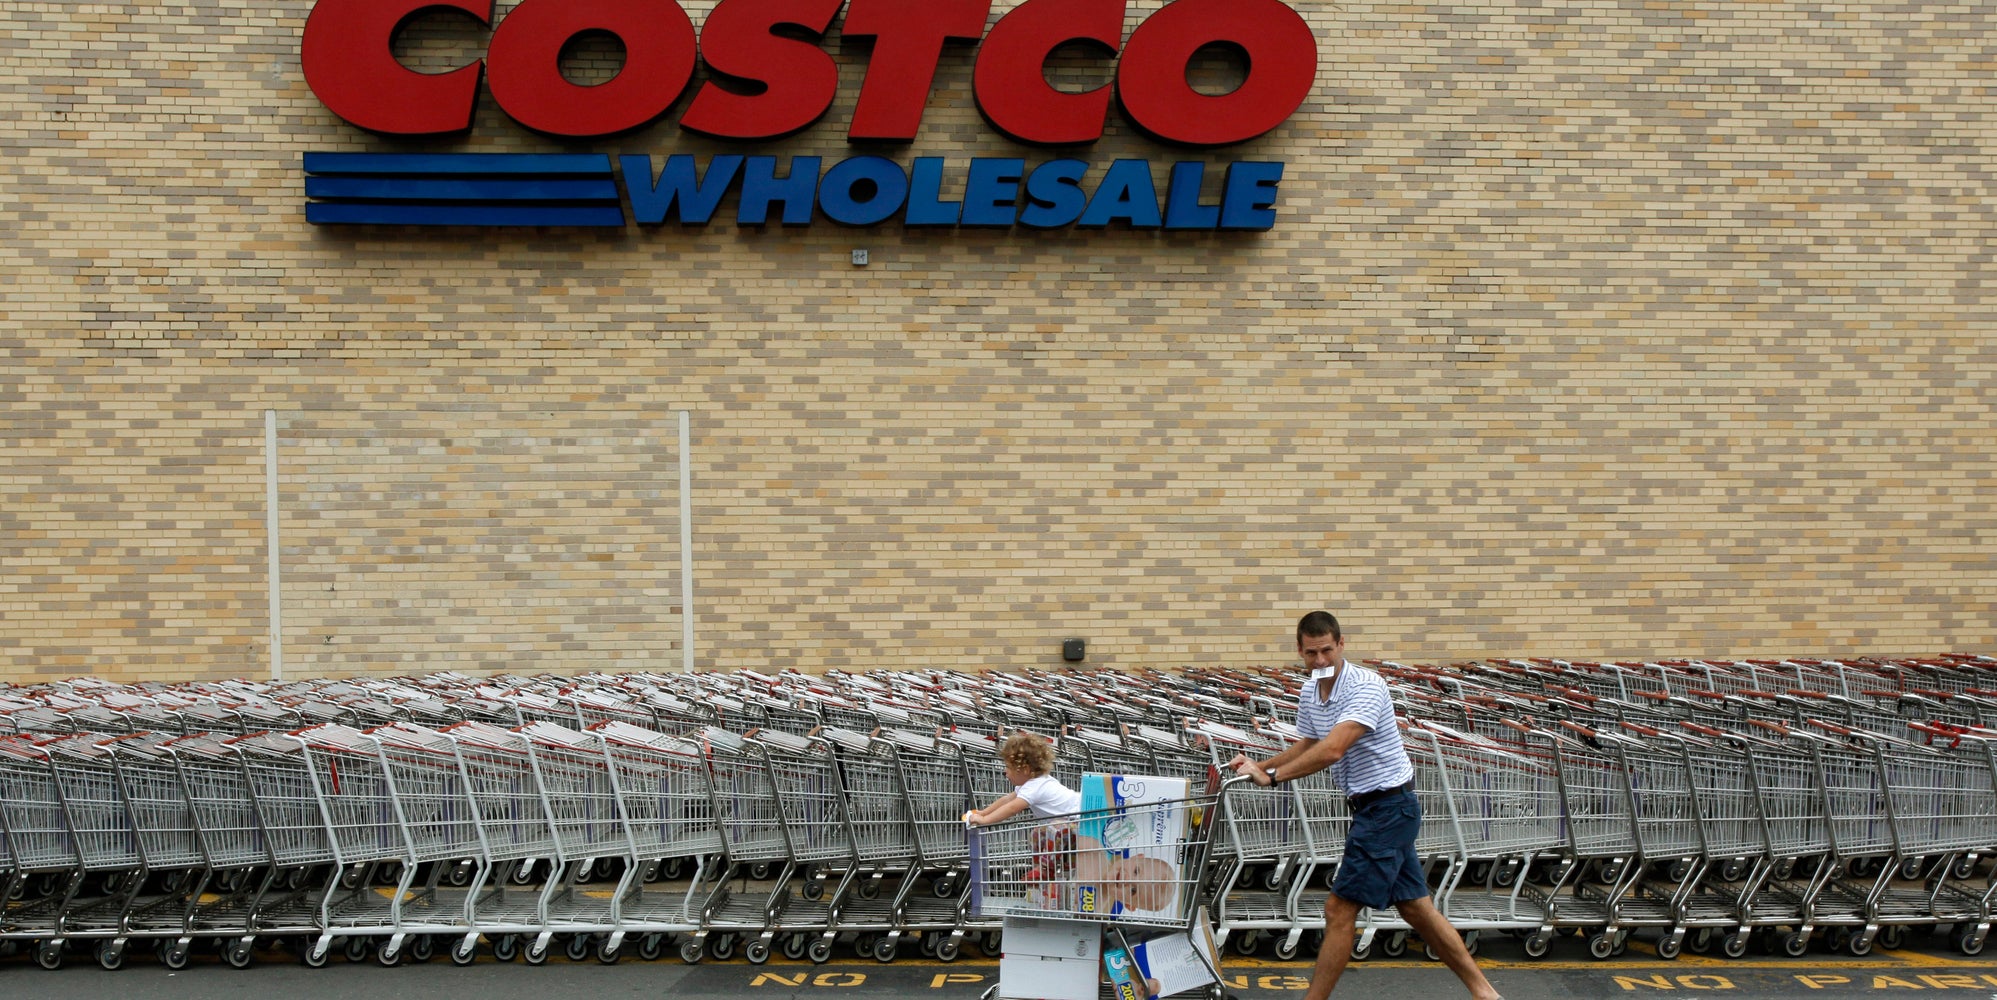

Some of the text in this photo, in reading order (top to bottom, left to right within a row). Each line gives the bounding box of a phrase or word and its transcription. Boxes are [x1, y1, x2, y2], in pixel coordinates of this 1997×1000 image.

[301, 0, 1317, 145] COSTCO
[619, 154, 1285, 231] WHOLESALE
[1117, 780, 1146, 799] 3
[1082, 889, 1095, 911] 208
[1110, 956, 1132, 970] 3
[750, 972, 867, 987] NO
[1611, 973, 1737, 990] NO
[1120, 983, 1136, 1000] 208
